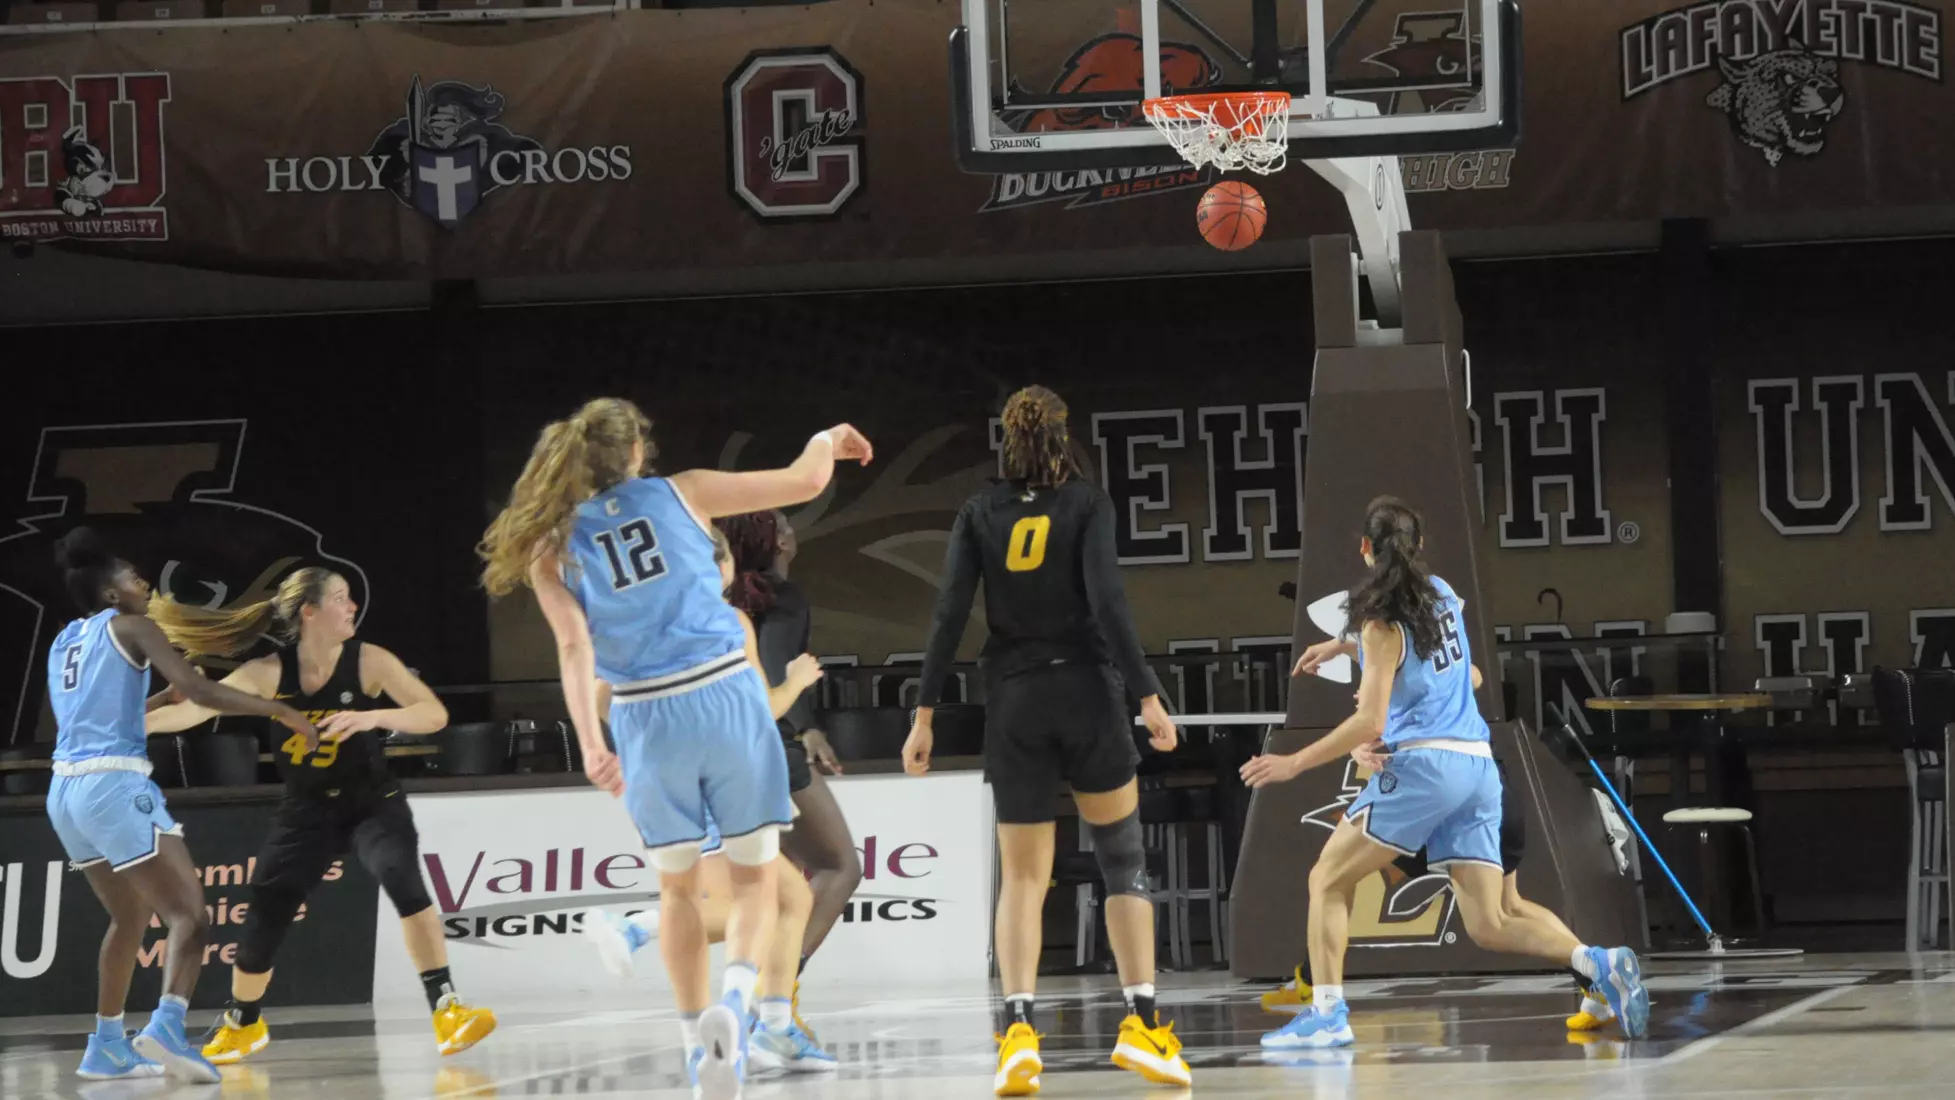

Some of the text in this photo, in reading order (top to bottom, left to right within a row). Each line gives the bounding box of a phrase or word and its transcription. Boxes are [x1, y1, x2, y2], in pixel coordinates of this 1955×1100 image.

[1622, 0, 1940, 98] LAFAYETTE
[0, 72, 171, 211] BU
[990, 137, 1041, 151] SPALDING
[264, 145, 632, 193] HOLY CROSS
[1102, 171, 1200, 199] BISON
[1401, 149, 1515, 193] HIGH
[1, 216, 158, 237] BOSTON UNIVERSITY
[592, 516, 669, 592] 12
[1006, 514, 1051, 572] 0
[62, 645, 83, 691] 5
[281, 732, 340, 767] 43
[423, 847, 648, 913] Valle
[0, 860, 64, 979] U
[444, 911, 587, 939] SIGNS
[137, 938, 239, 968] Mre
